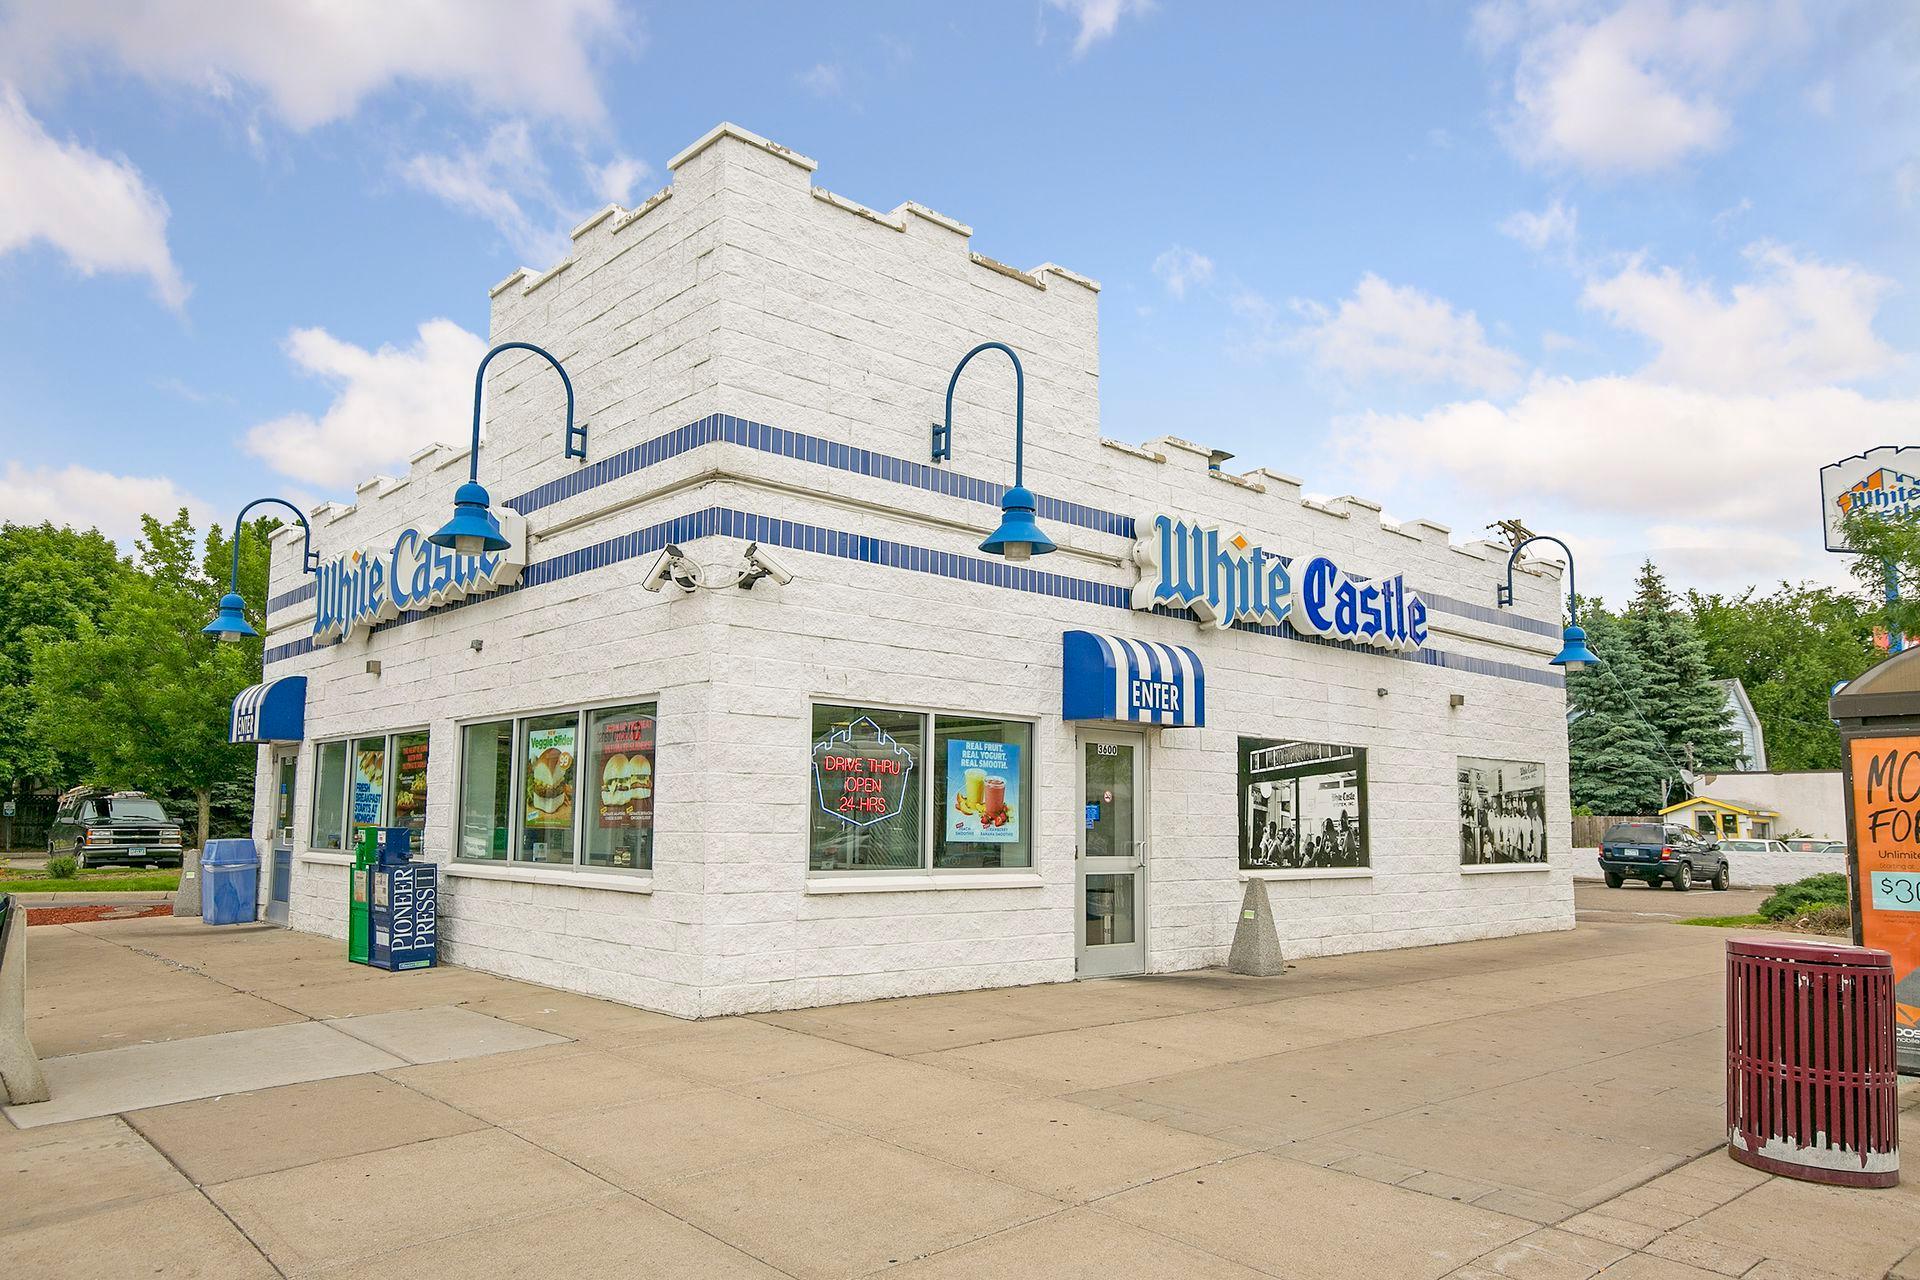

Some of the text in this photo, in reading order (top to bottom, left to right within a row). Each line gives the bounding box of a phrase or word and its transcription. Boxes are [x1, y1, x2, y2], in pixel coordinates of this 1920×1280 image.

[1849, 486, 1920, 509] White
[1155, 515, 1428, 646] White Castle
[313, 549, 384, 640] White
[1132, 680, 1180, 711] ENTER
[237, 714, 254, 736] ENTER
[531, 734, 573, 749] Veggie Slider
[966, 742, 1004, 752] REAL FRUIT.
[1098, 744, 1117, 755] 3600
[961, 758, 1008, 769] REAL SMOOTH.
[962, 750, 1008, 761] REAL YOGURT.
[825, 755, 901, 775] DRIVE THRU
[356, 782, 371, 792] FRESH
[845, 776, 882, 793] OPEN
[355, 792, 382, 804] BREAKFAST
[839, 796, 886, 813] 24 HRS
[354, 802, 379, 814] STARTS AT
[1868, 808, 1920, 843] FO
[1881, 877, 1920, 904] $3
[391, 867, 414, 952] PIONEER
[413, 888, 436, 950] PRESS
